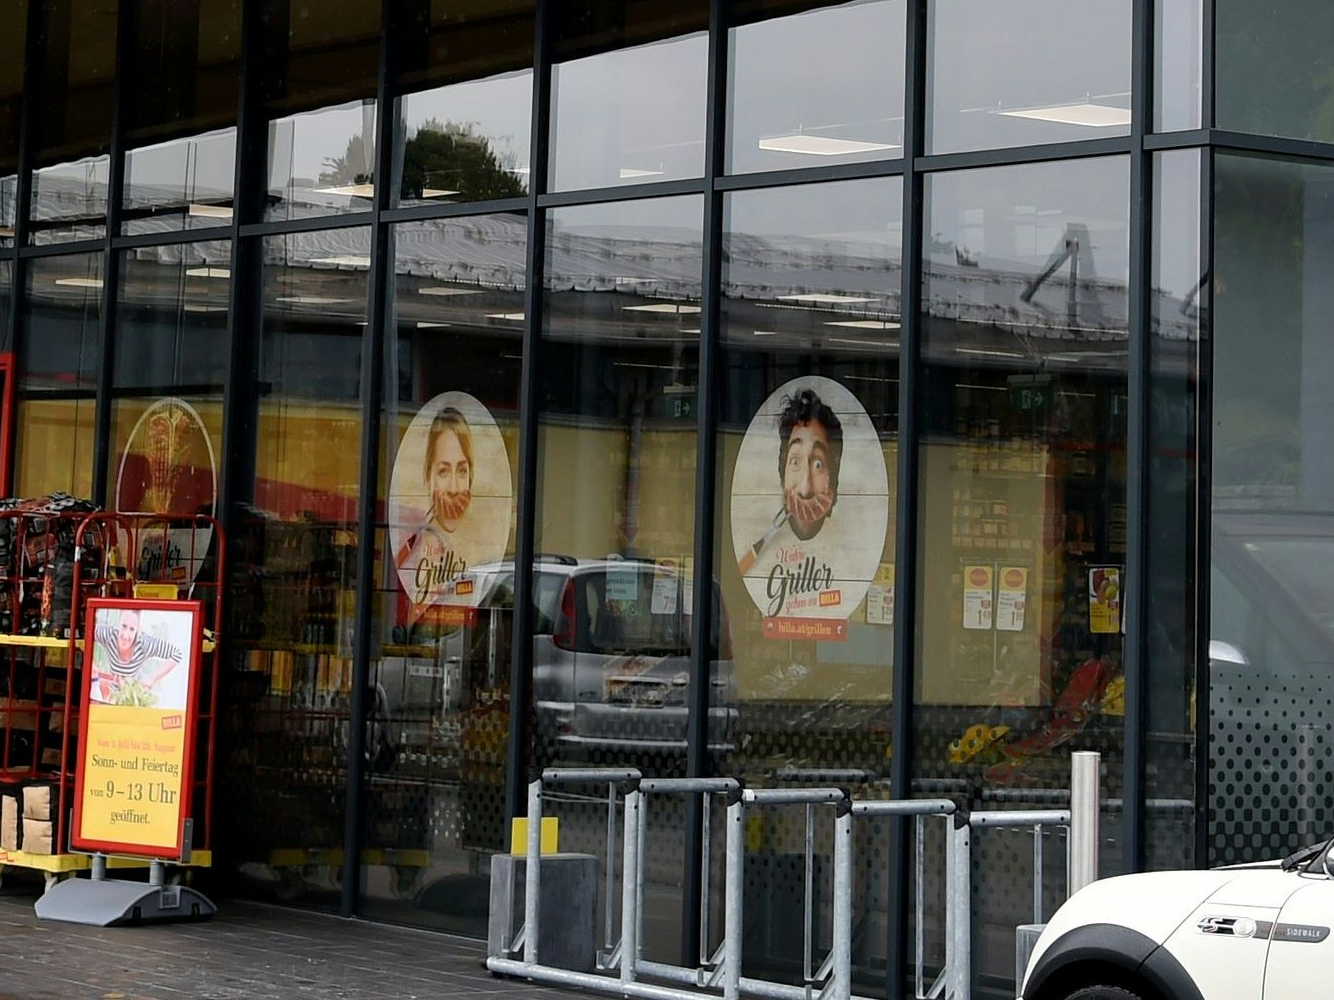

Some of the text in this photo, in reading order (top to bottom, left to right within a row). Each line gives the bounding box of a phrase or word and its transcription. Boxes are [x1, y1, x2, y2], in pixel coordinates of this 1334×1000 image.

[415, 550, 468, 604] Griller
[766, 556, 835, 618] Griller
[820, 590, 840, 606] BILLA
[778, 621, 832, 637] billa.at/grillen
[91, 753, 179, 777] Sonn- und Feiertag
[90, 788, 104, 797] von
[148, 782, 177, 804] Uhr
[109, 809, 151, 825] geöffnet.
[1286, 928, 1322, 938] SIDEWALK
